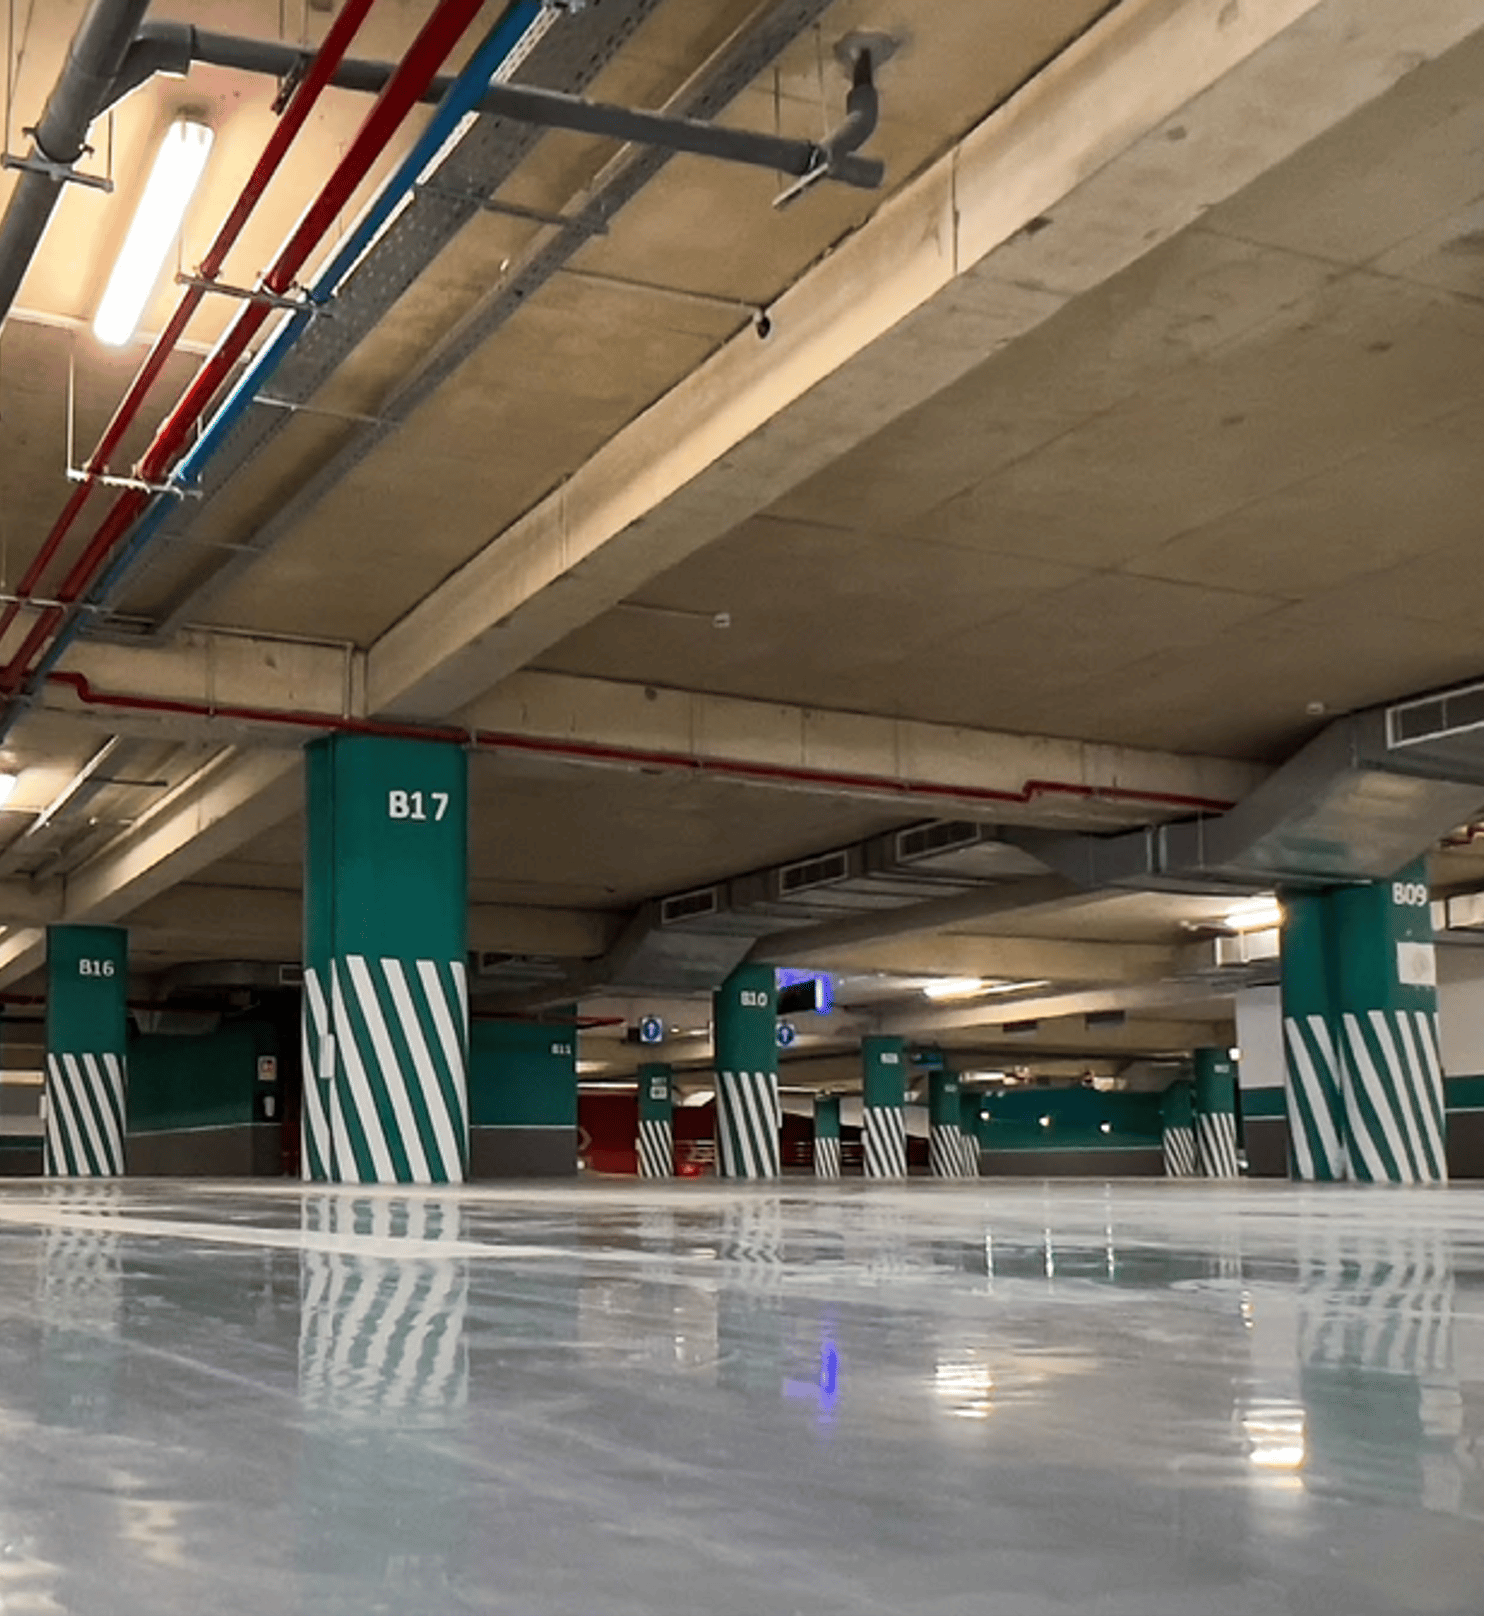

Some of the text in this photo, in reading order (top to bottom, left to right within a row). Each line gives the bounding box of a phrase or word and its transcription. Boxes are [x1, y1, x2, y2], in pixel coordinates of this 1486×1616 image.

[389, 790, 449, 821] B17
[1392, 882, 1428, 907] B09
[79, 958, 115, 977] B16
